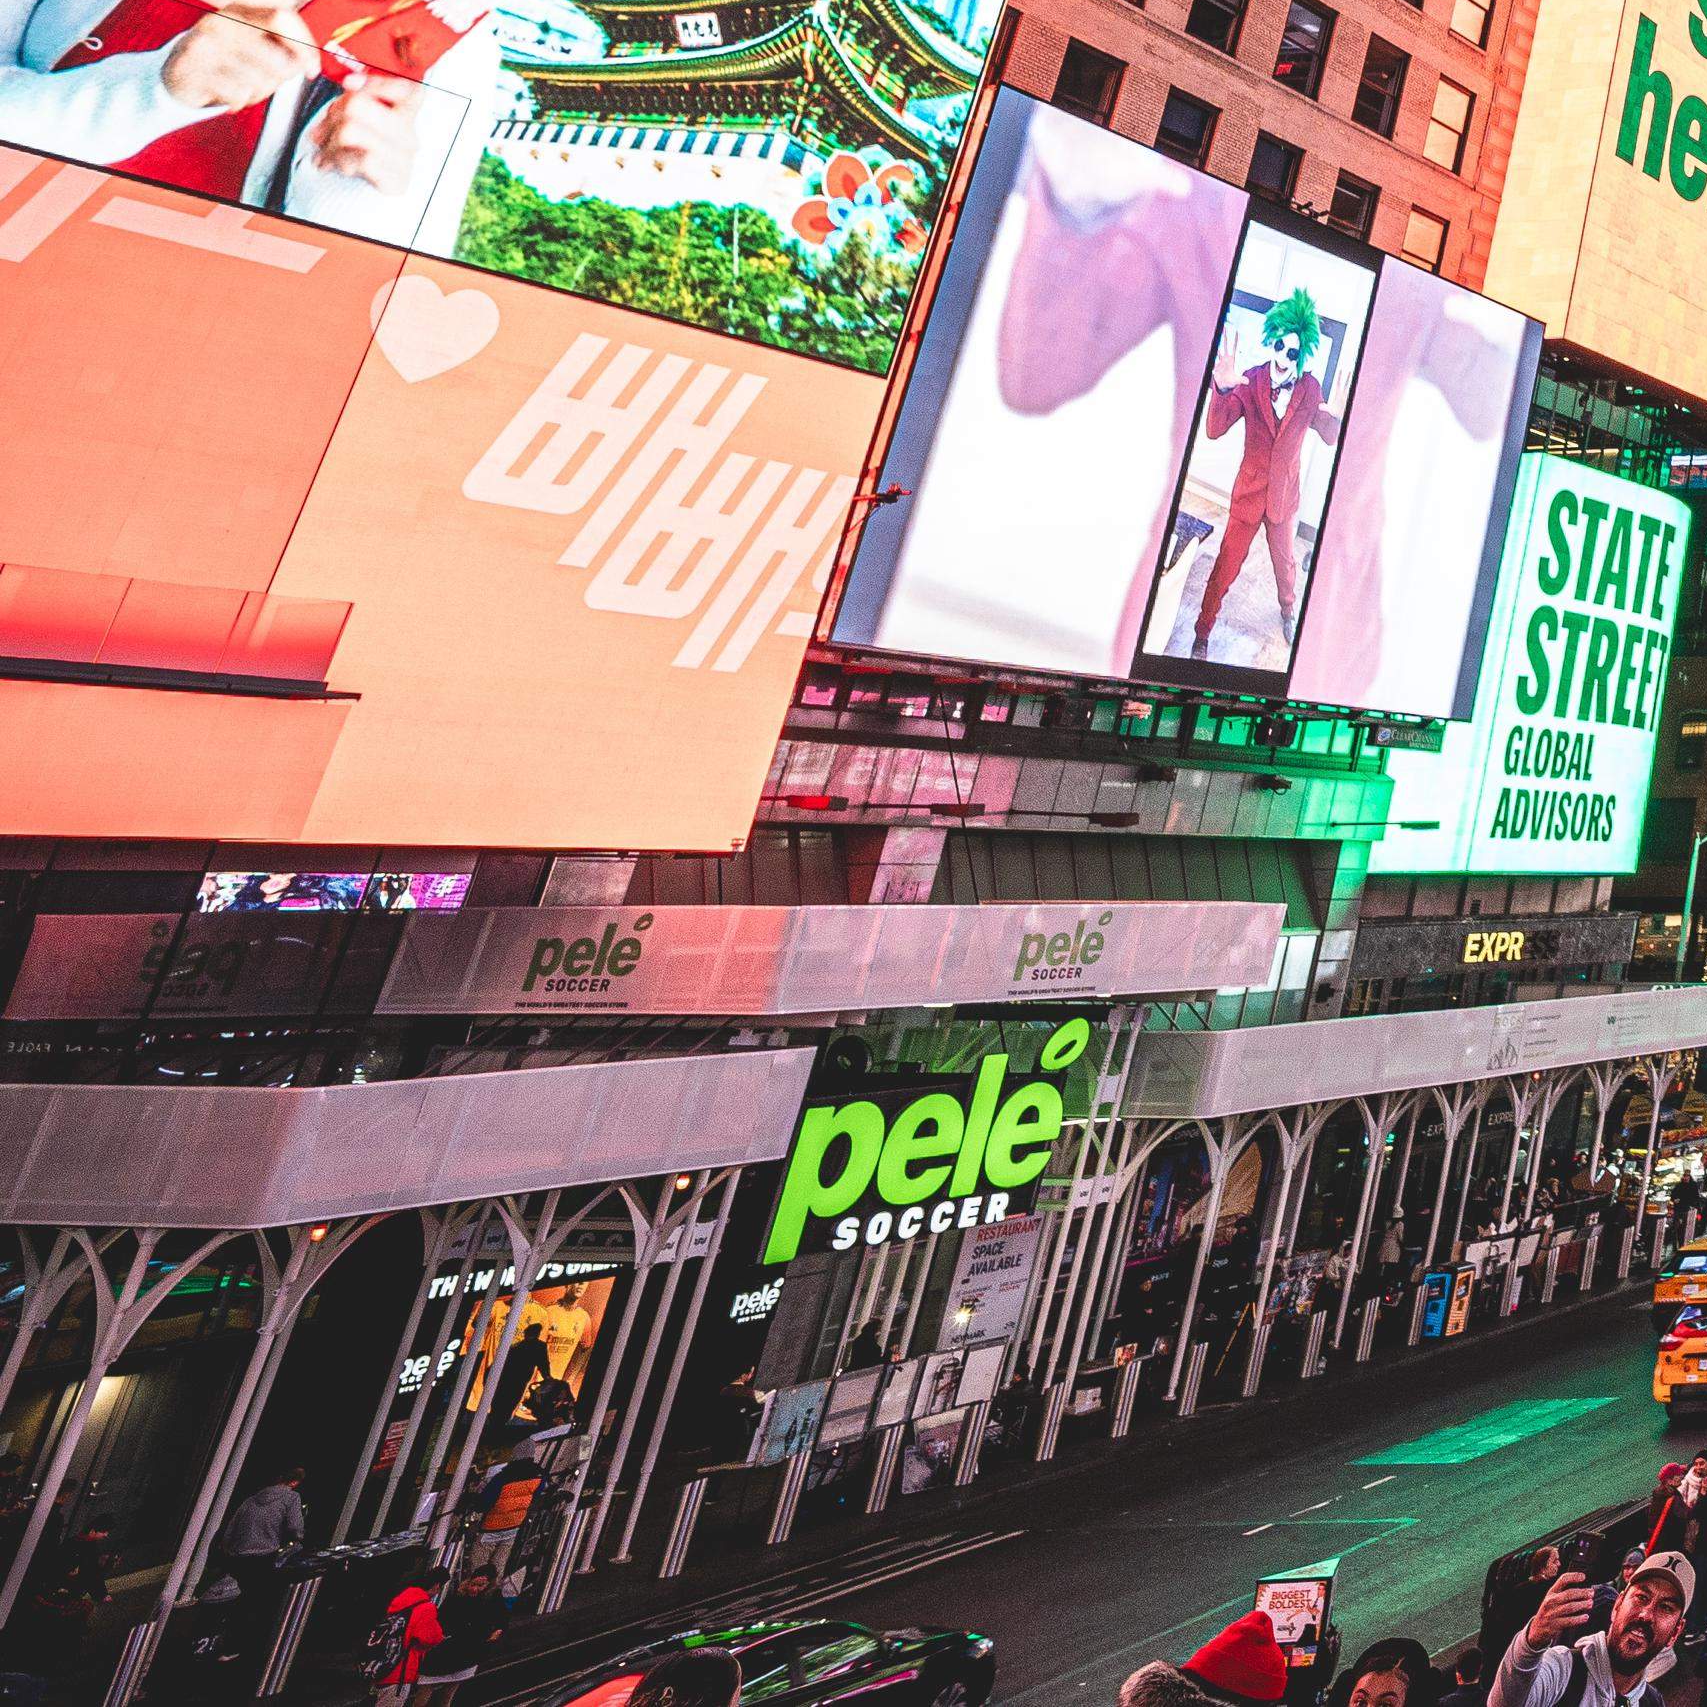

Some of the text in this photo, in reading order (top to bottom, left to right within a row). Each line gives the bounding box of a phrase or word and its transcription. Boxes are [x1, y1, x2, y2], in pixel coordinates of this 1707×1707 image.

[1539, 488, 1679, 621] STATE
[1502, 727, 1594, 783] GLOBAL
[1490, 789, 1617, 844] ADVISORS
[522, 913, 654, 992] pelé
[1013, 911, 1112, 982] pelé
[544, 978, 610, 992] SOCCER
[1031, 967, 1082, 980] SOCCER
[763, 1017, 1090, 1266] pelé
[833, 1193, 1010, 1251] SOCCER
[976, 1217, 1042, 1243] RESTAURANT
[968, 1253, 1022, 1276] AVAILABLE
[972, 1242, 1005, 1260] SPACE
[1268, 1599, 1312, 1610] BOLDEST
[1272, 1589, 1311, 1600] BIGGEST
